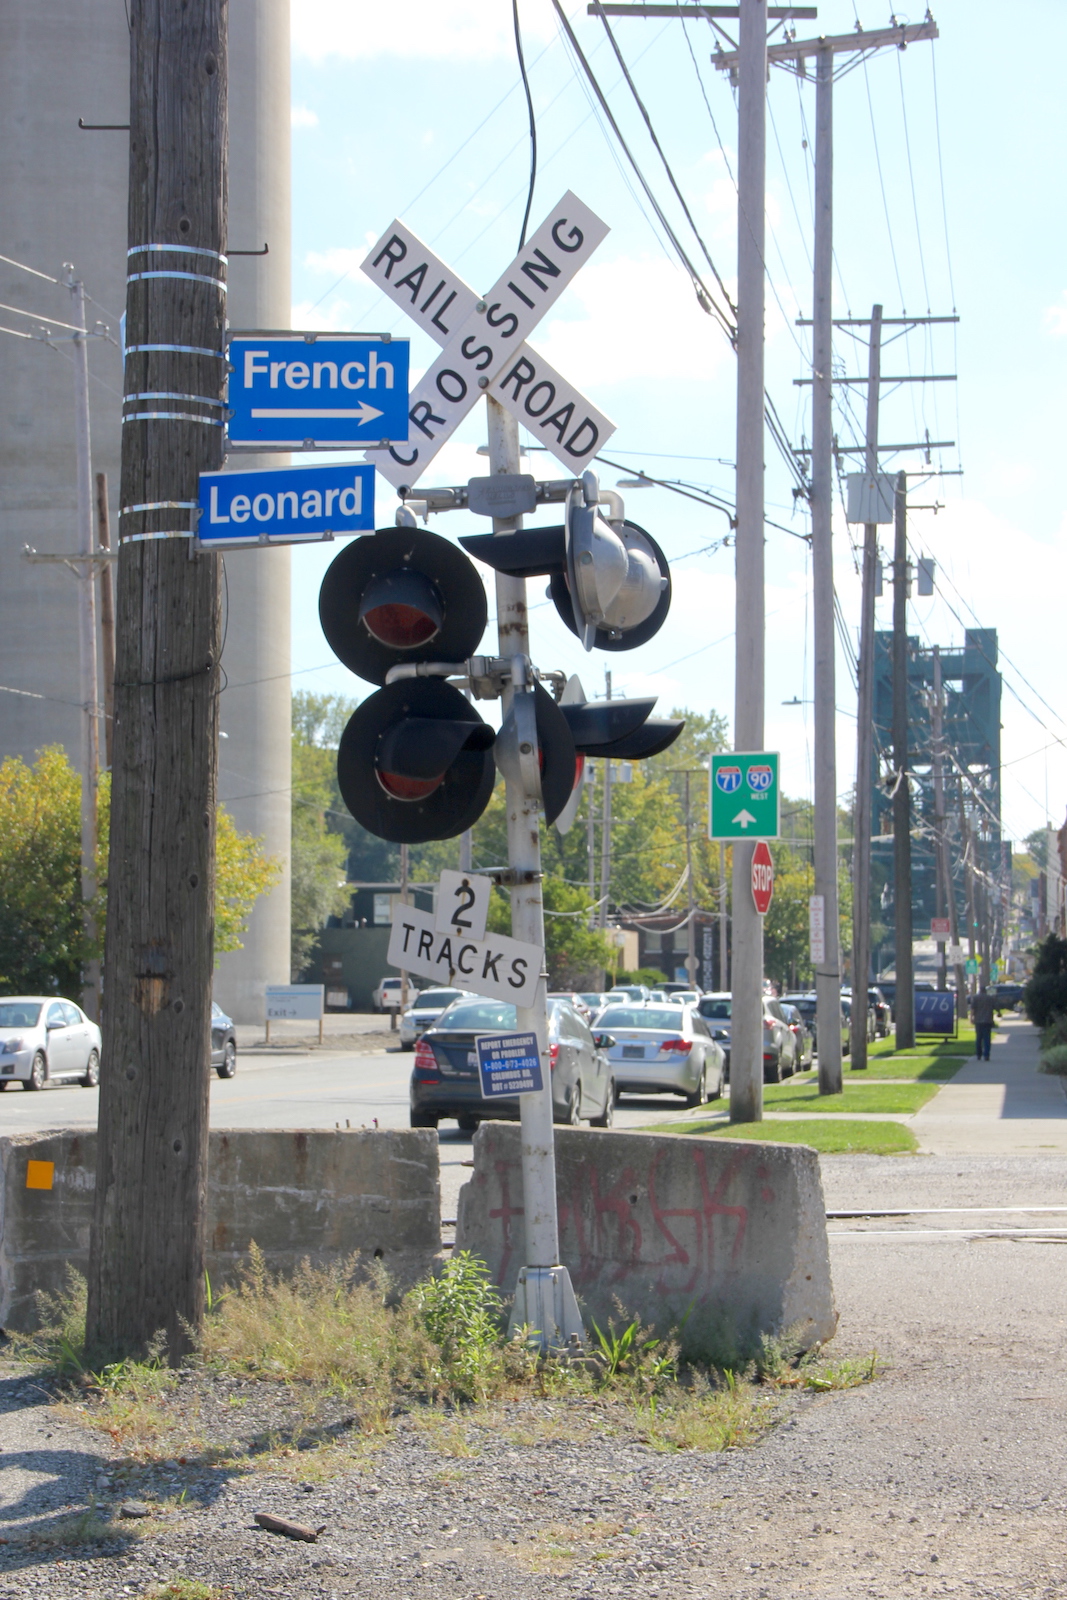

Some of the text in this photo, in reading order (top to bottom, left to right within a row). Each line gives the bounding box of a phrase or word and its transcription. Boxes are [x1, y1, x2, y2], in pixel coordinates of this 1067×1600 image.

[372, 234, 458, 335] RAIL
[389, 217, 585, 468] CROSSING
[243, 350, 395, 390] French
[499, 356, 600, 458] ROAD
[209, 475, 363, 525] Leonard
[720, 772, 770, 789] 71 90
[750, 792, 768, 800] WEST
[753, 863, 772, 891] STOP
[450, 886, 476, 928] 2
[402, 923, 528, 989] TRACKS
[268, 1008, 287, 1017] Exit
[919, 996, 949, 1011] 776
[481, 1036, 534, 1050] REPORT EMERGENCY
[501, 1048, 526, 1059] PROBLEM
